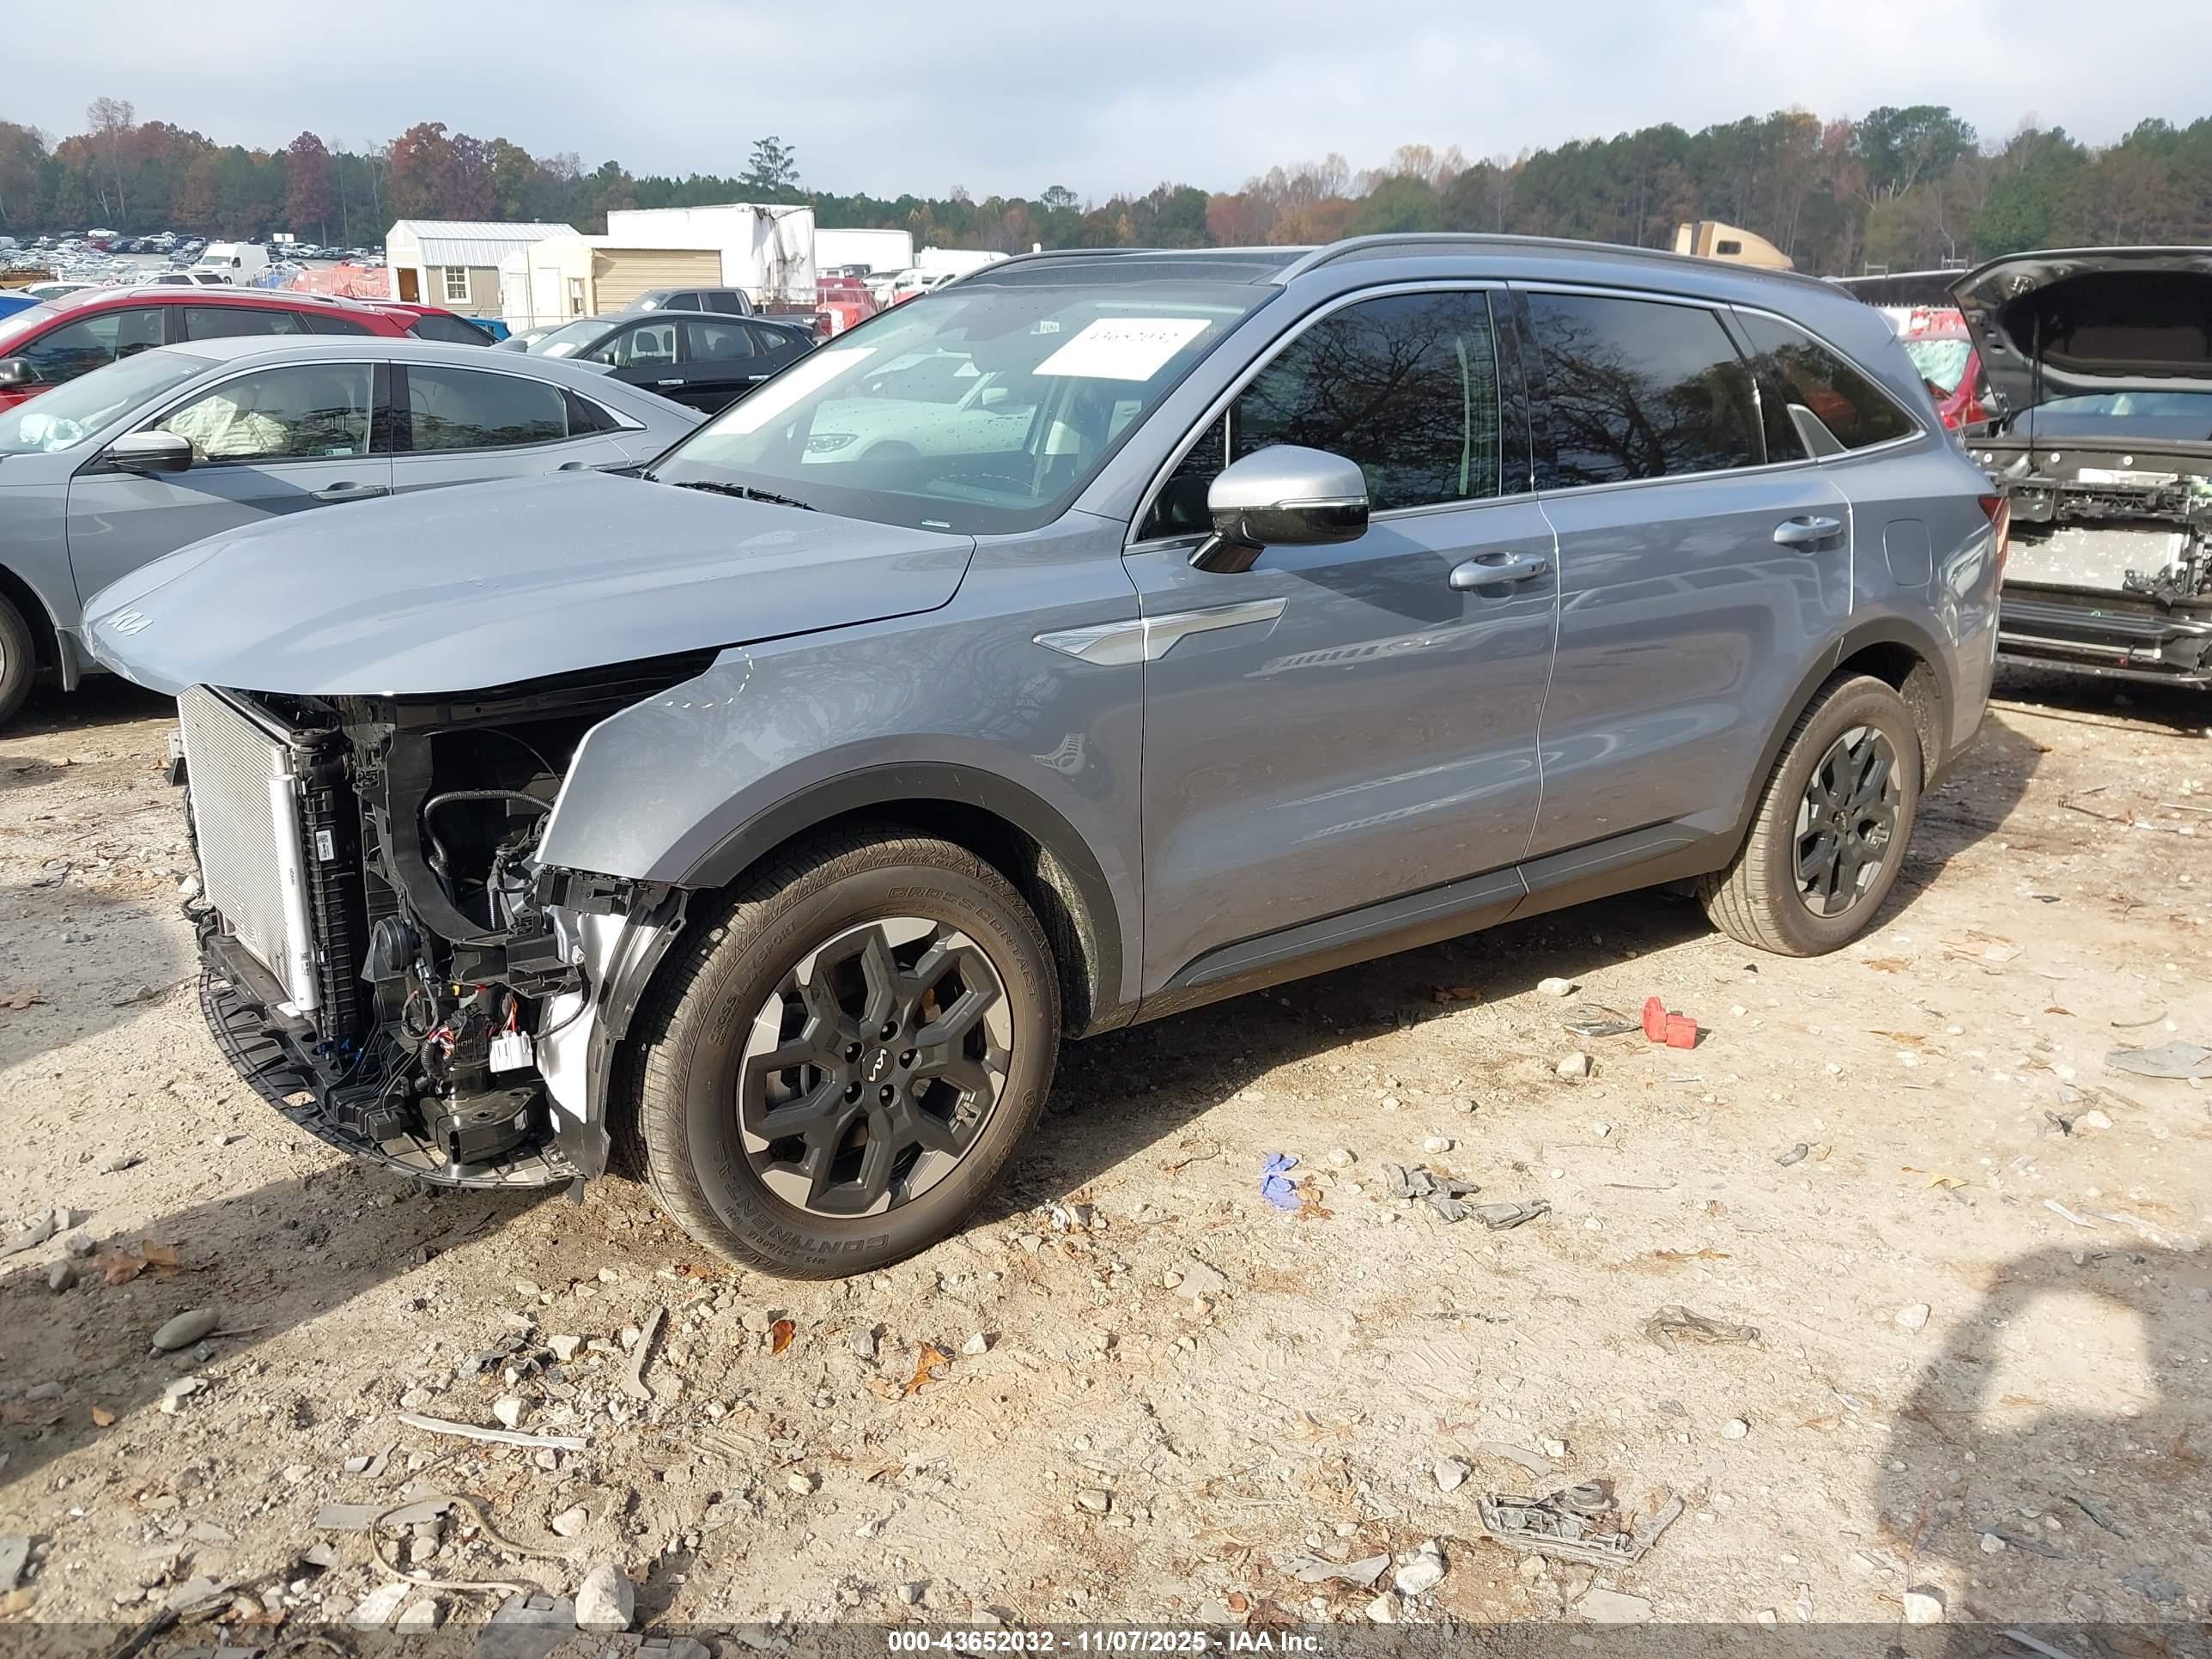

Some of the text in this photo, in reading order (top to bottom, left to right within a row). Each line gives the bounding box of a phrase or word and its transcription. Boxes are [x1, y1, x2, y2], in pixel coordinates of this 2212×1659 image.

[756, 920, 799, 963] SPORT
[887, 886, 977, 911] CROSS
[975, 908, 1039, 1003] CONTACT
[711, 1140, 890, 1259] CONTINENTAL
